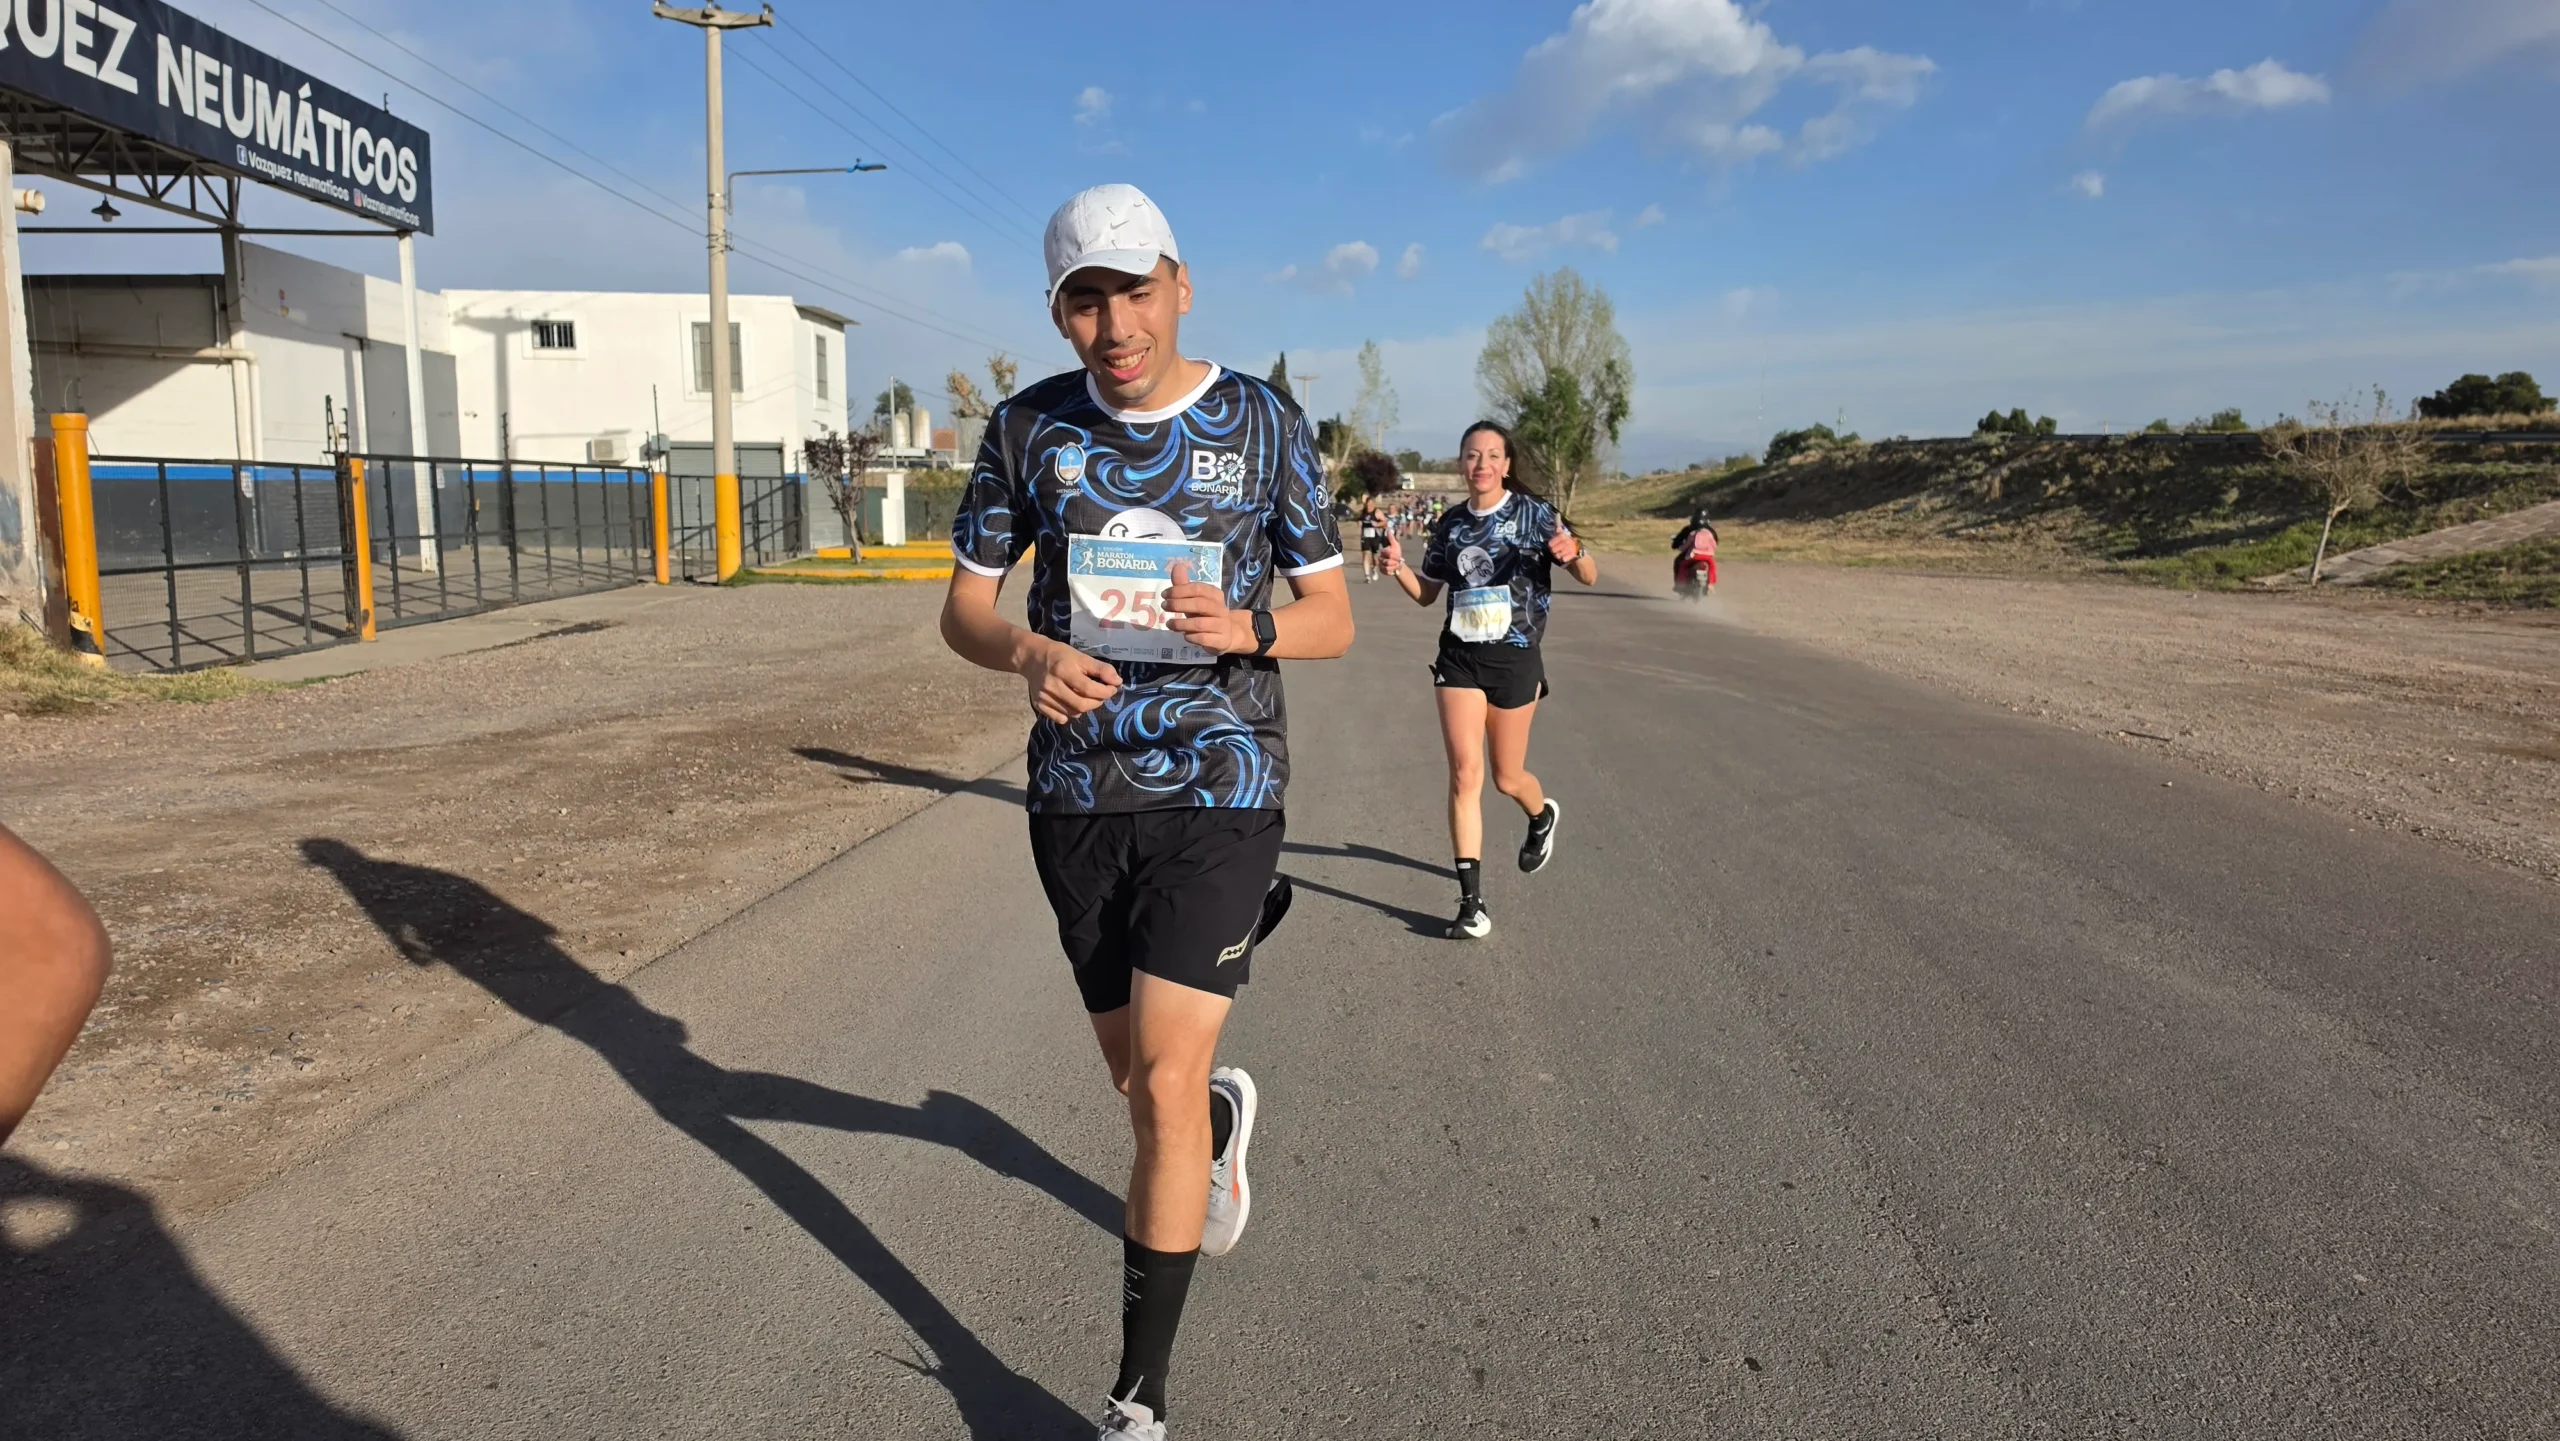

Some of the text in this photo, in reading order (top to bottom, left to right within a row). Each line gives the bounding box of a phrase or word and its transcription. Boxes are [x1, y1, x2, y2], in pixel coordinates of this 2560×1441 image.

[0, 0, 419, 203] UEZ NEUMÁTICOS
[248, 150, 350, 201] Vazquez neumaticos
[1191, 482, 1243, 497] BONARDA
[1096, 557, 1159, 571] BONARDA
[1097, 551, 1135, 560] MARATÓN
[1099, 588, 1183, 632] 25
